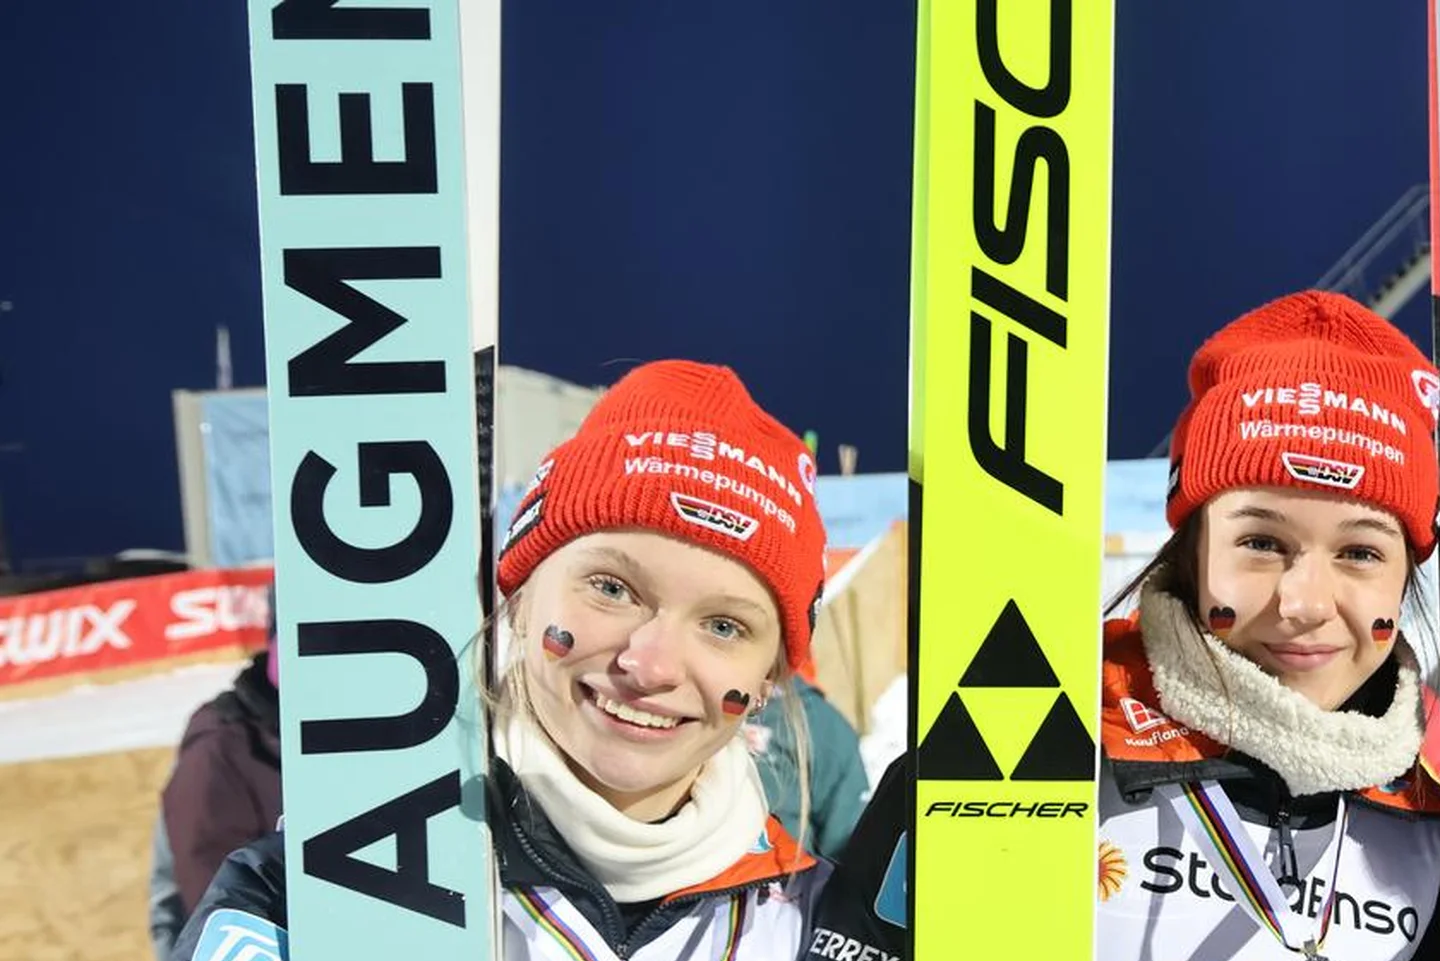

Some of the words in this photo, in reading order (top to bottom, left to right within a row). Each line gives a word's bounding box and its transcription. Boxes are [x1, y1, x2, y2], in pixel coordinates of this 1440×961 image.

[272, 0, 467, 929] AUGME
[1239, 419, 1405, 465] Wärmepumpen
[624, 458, 796, 534] Wärmepumpen
[924, 801, 1089, 819] FISCHER
